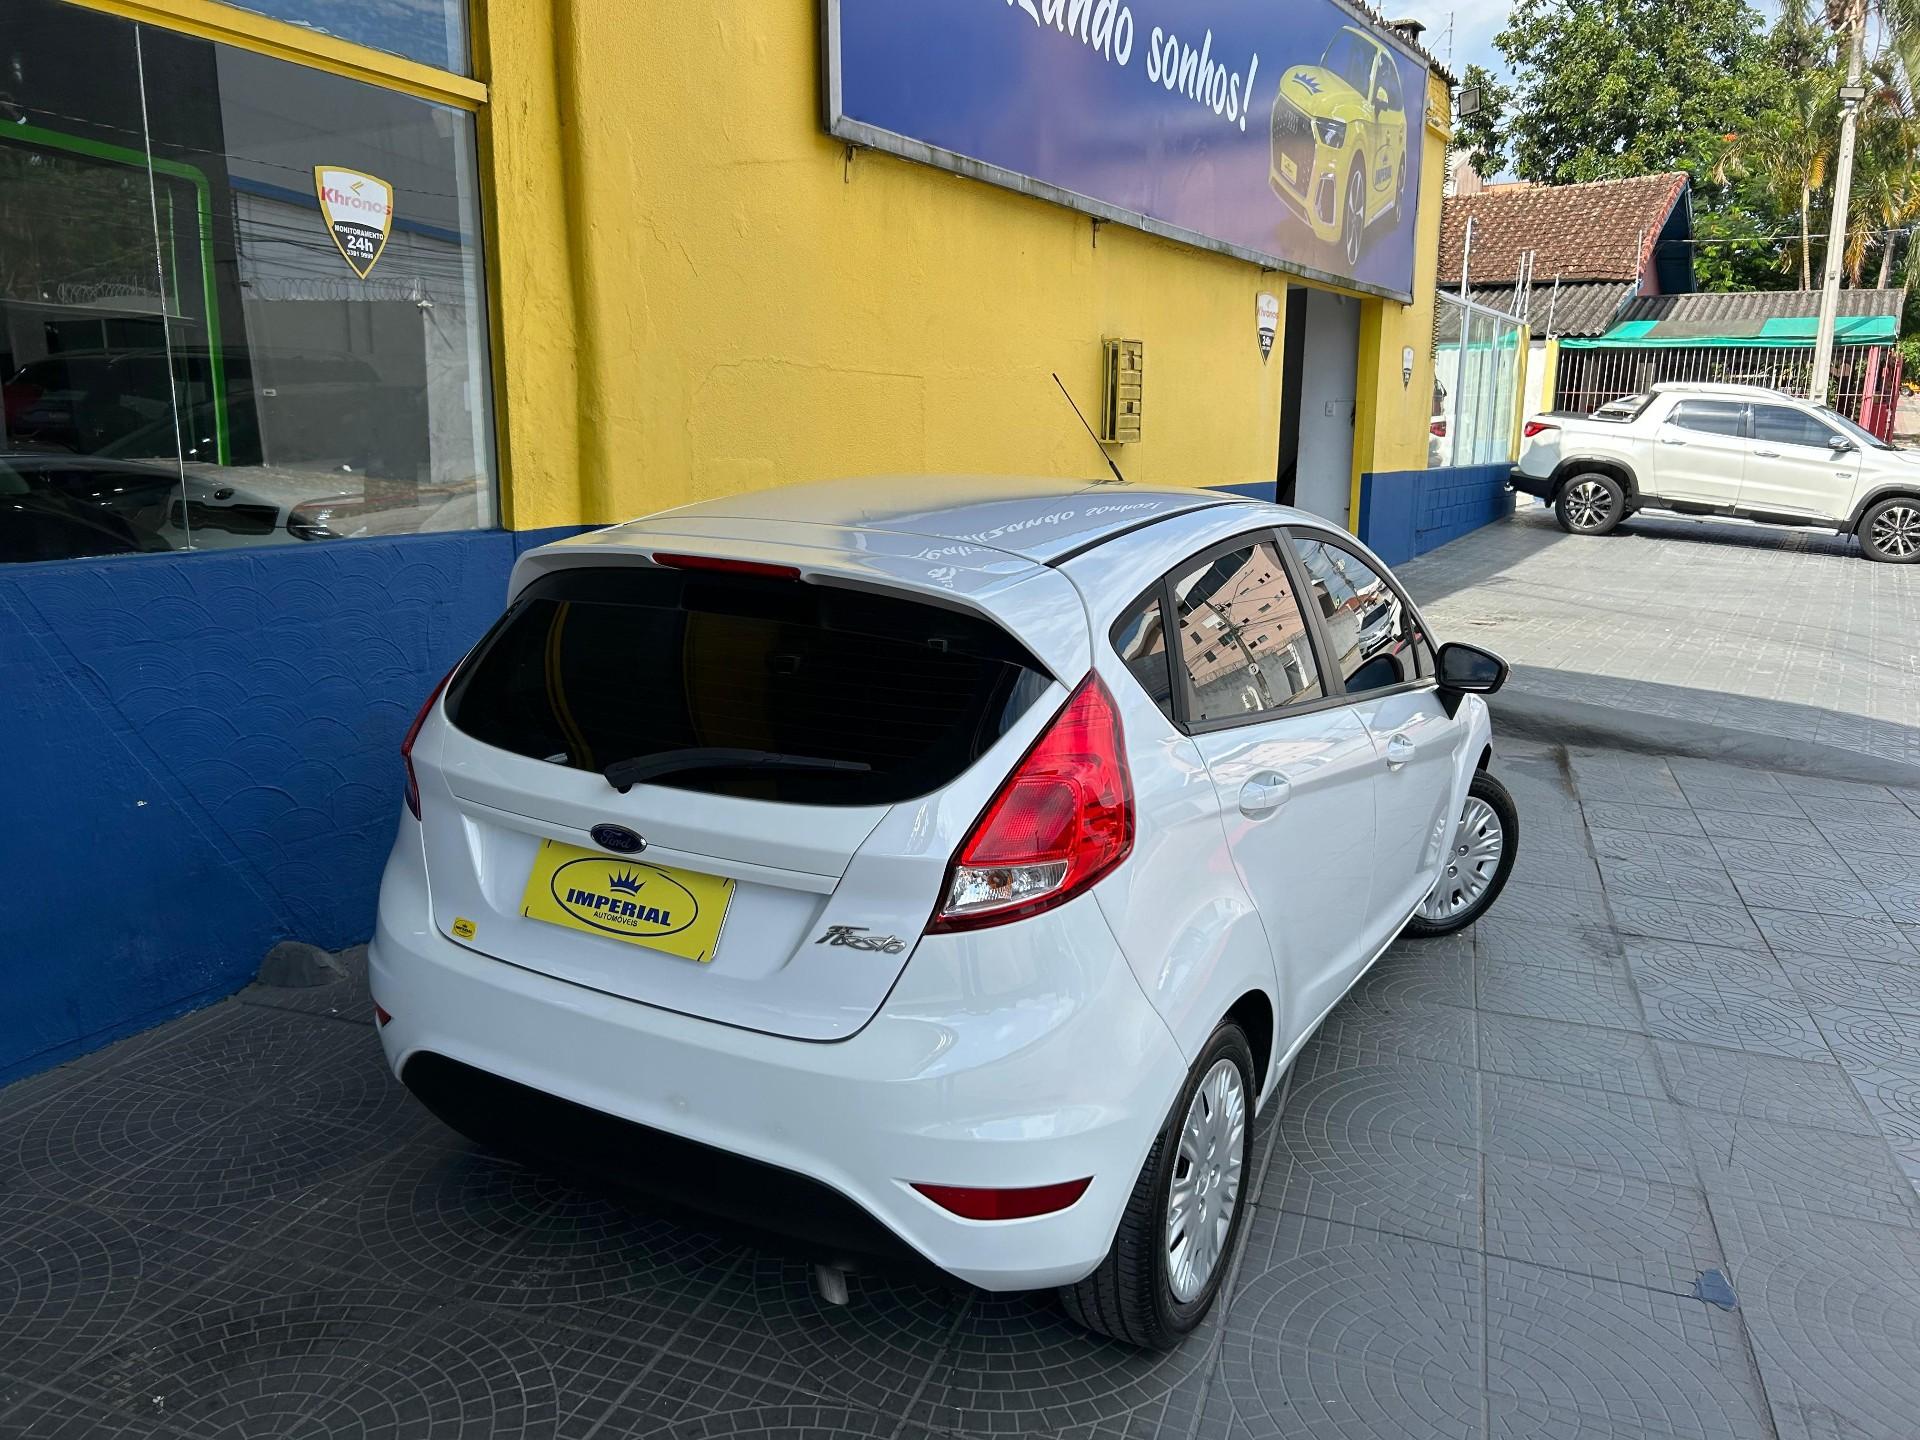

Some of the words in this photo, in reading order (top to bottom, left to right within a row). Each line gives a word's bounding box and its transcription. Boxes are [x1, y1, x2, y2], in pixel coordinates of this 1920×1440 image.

[1146, 26, 1259, 132] sonhos!
[321, 186, 391, 215] Khronos
[334, 224, 384, 240] MONITORAMENTO
[347, 235, 373, 252] 24h
[601, 830, 634, 849] Ford
[566, 888, 671, 927] IMPERIAL
[815, 926, 907, 954] Fiesta
